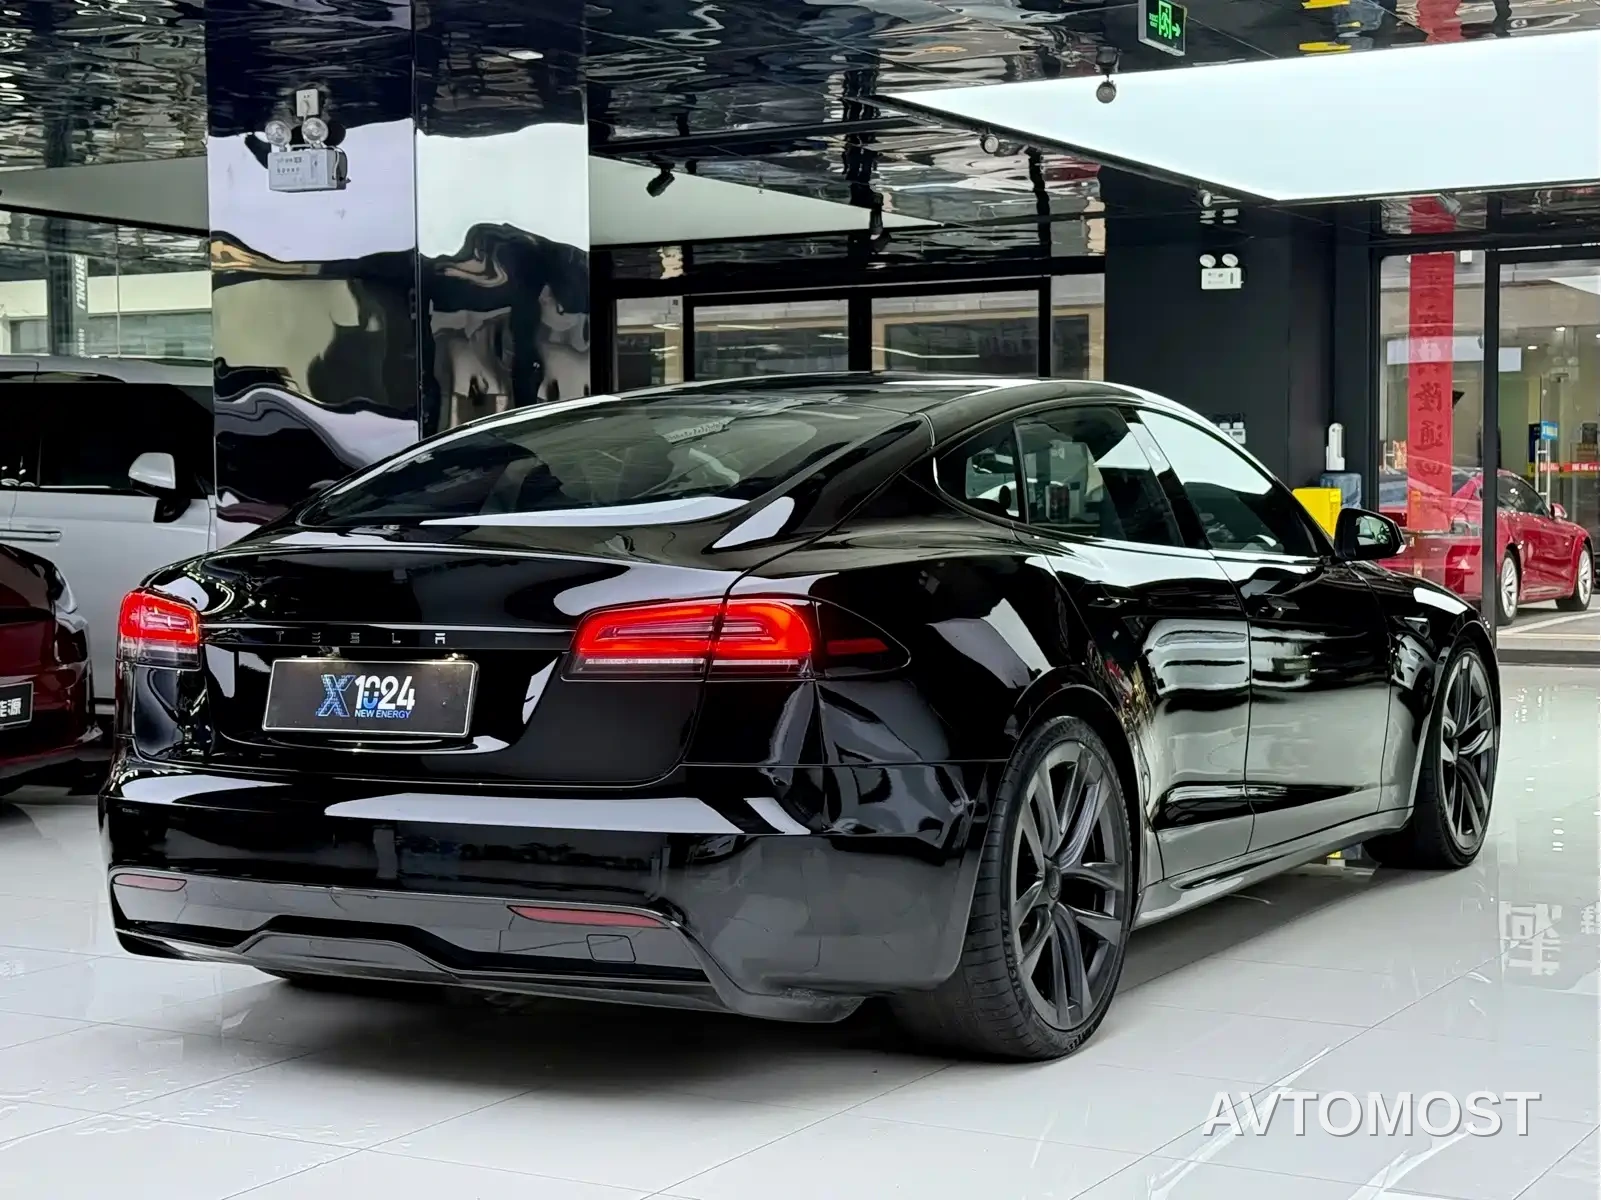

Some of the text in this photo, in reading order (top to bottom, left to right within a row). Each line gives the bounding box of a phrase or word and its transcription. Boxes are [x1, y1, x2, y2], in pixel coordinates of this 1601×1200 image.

[276, 631, 446, 644] TESLA
[354, 709, 412, 719] NEW ENERGY
